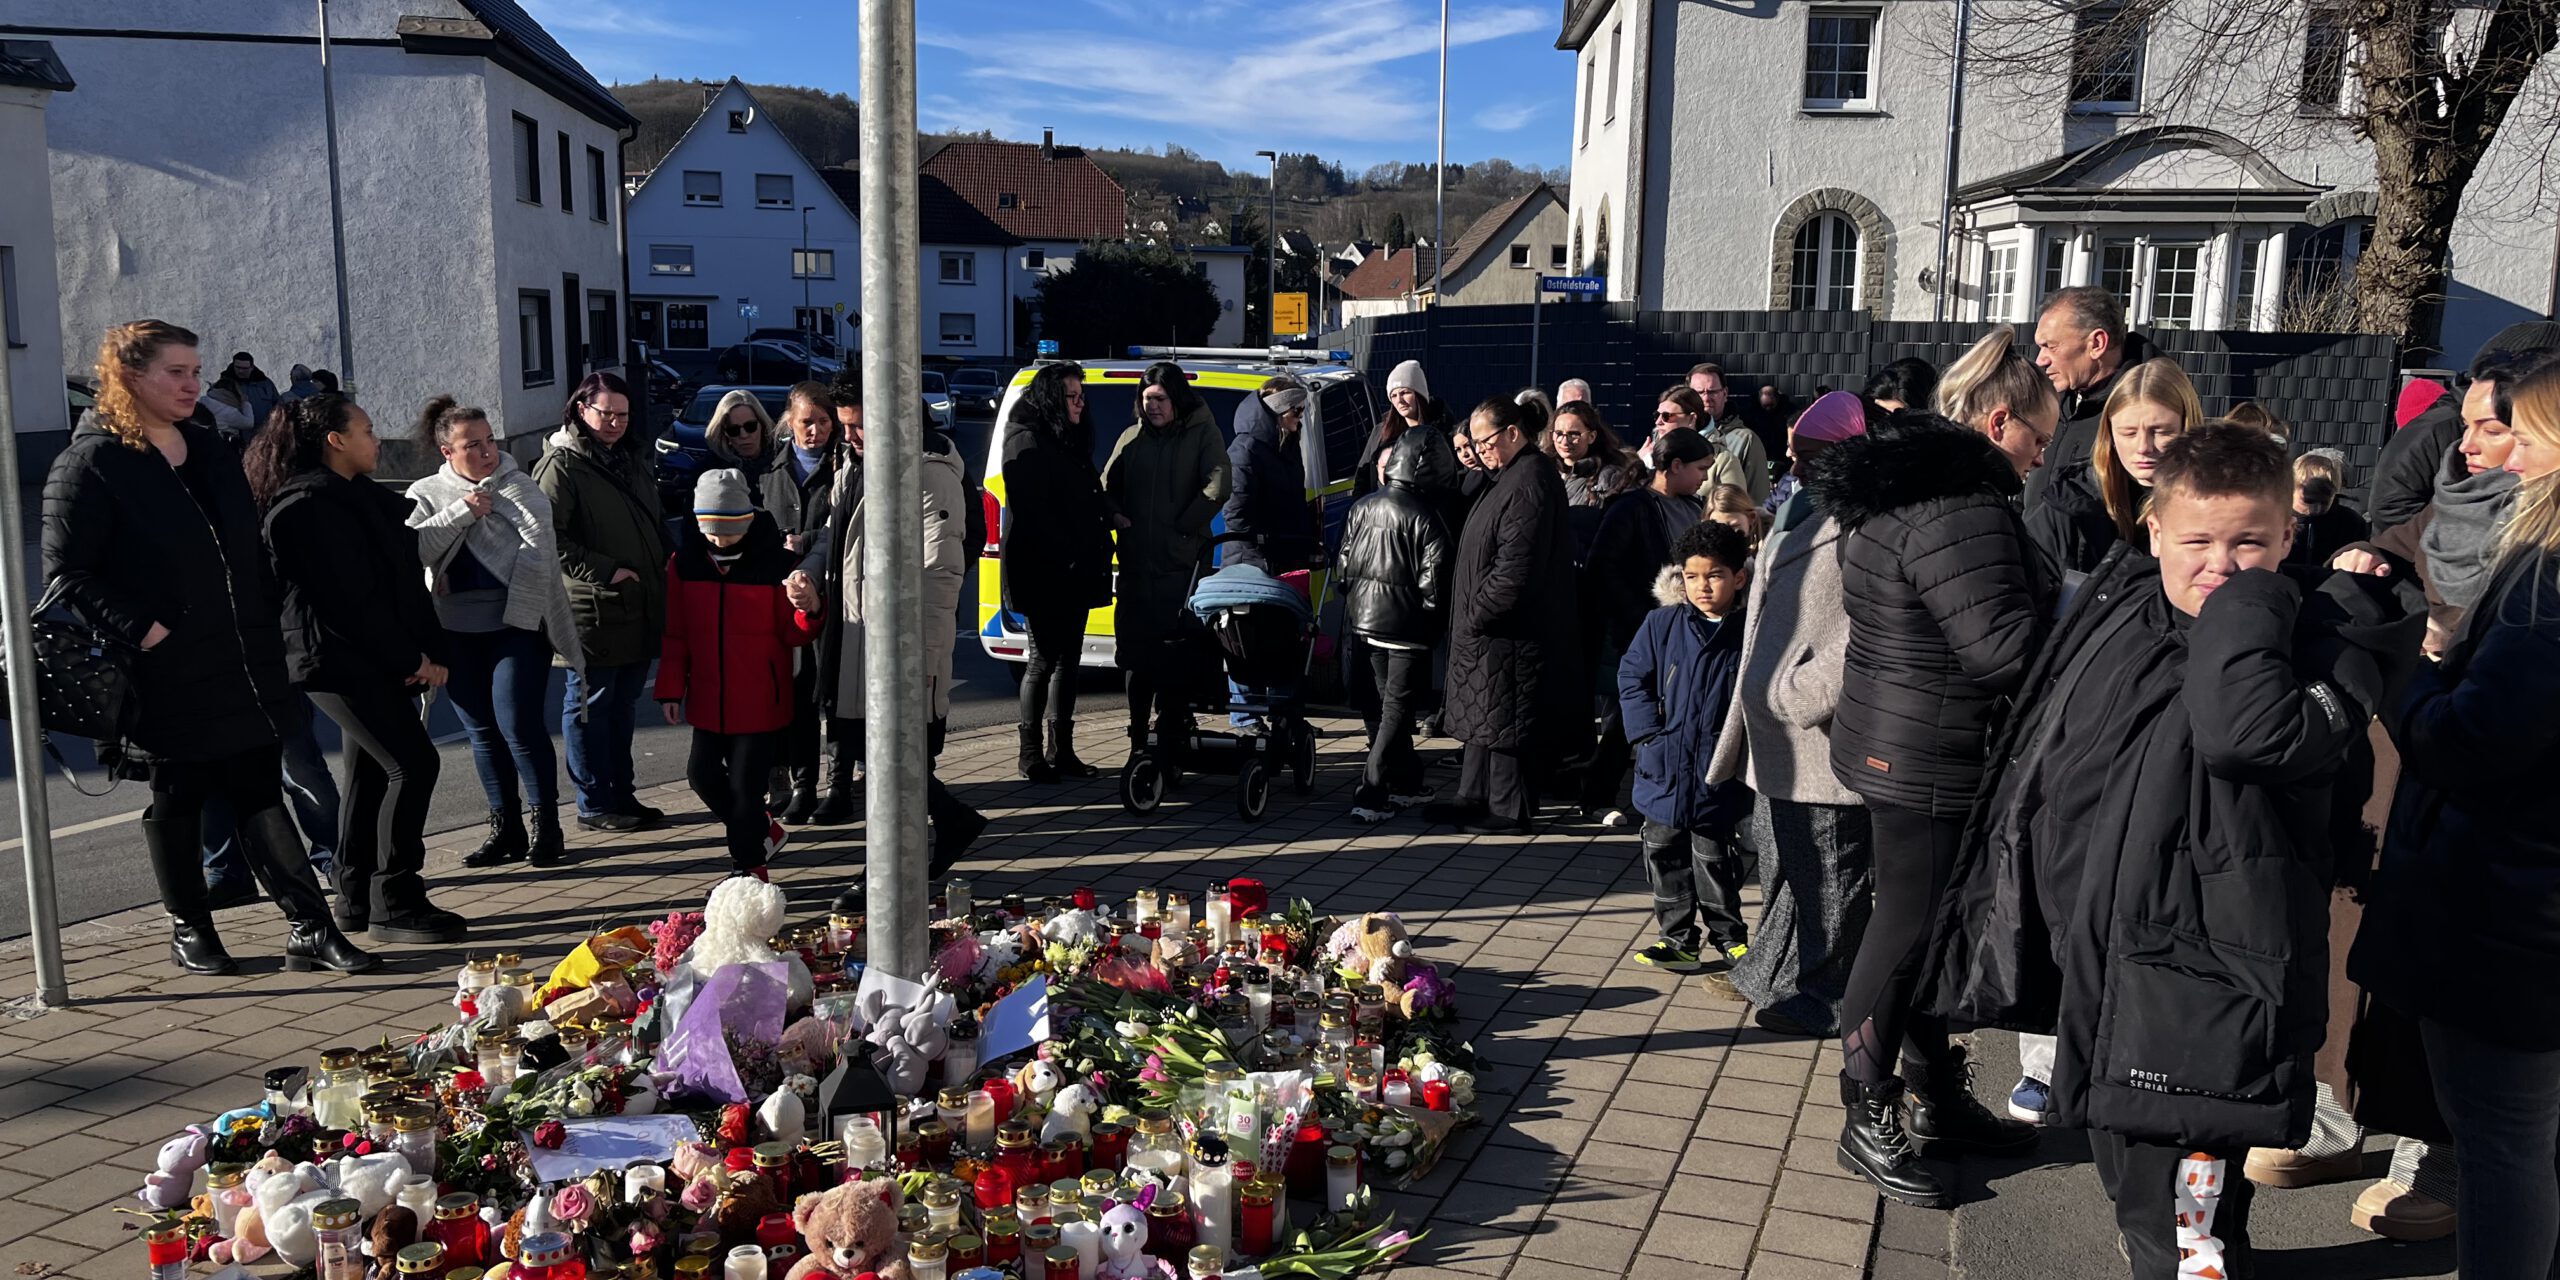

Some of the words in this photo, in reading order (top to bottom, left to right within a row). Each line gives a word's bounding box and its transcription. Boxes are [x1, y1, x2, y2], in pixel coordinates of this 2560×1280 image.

[1546, 279, 1600, 291] Ostfeldstraße
[2130, 1080, 2168, 1093] SERIAL
[1238, 1114, 1251, 1124] 30
